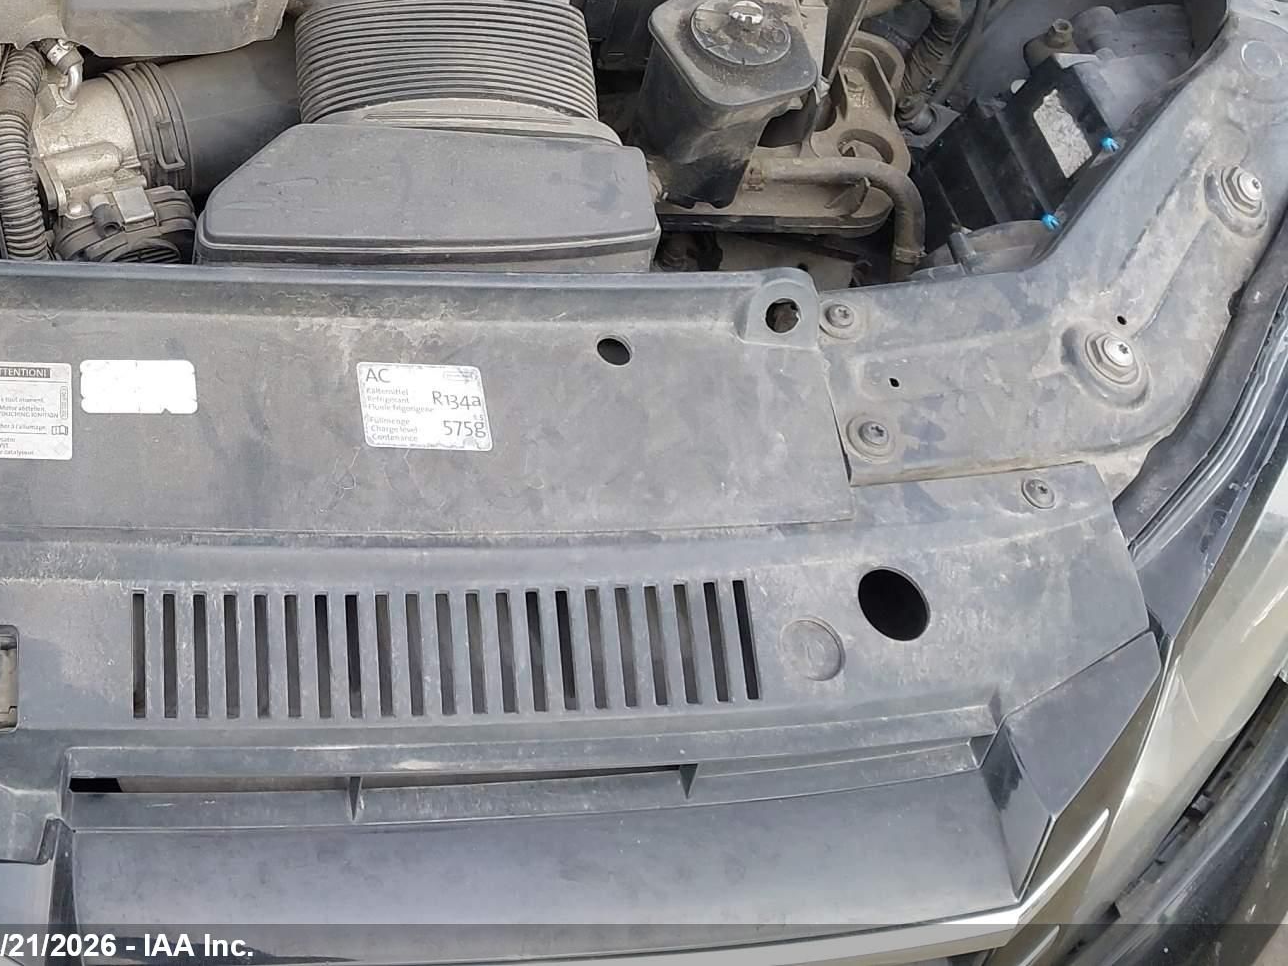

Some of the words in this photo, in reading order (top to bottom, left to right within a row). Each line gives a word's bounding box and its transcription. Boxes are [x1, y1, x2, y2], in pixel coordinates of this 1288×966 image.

[366, 368, 391, 383] AC
[432, 390, 482, 410] R134a
[443, 420, 486, 438] 575g
